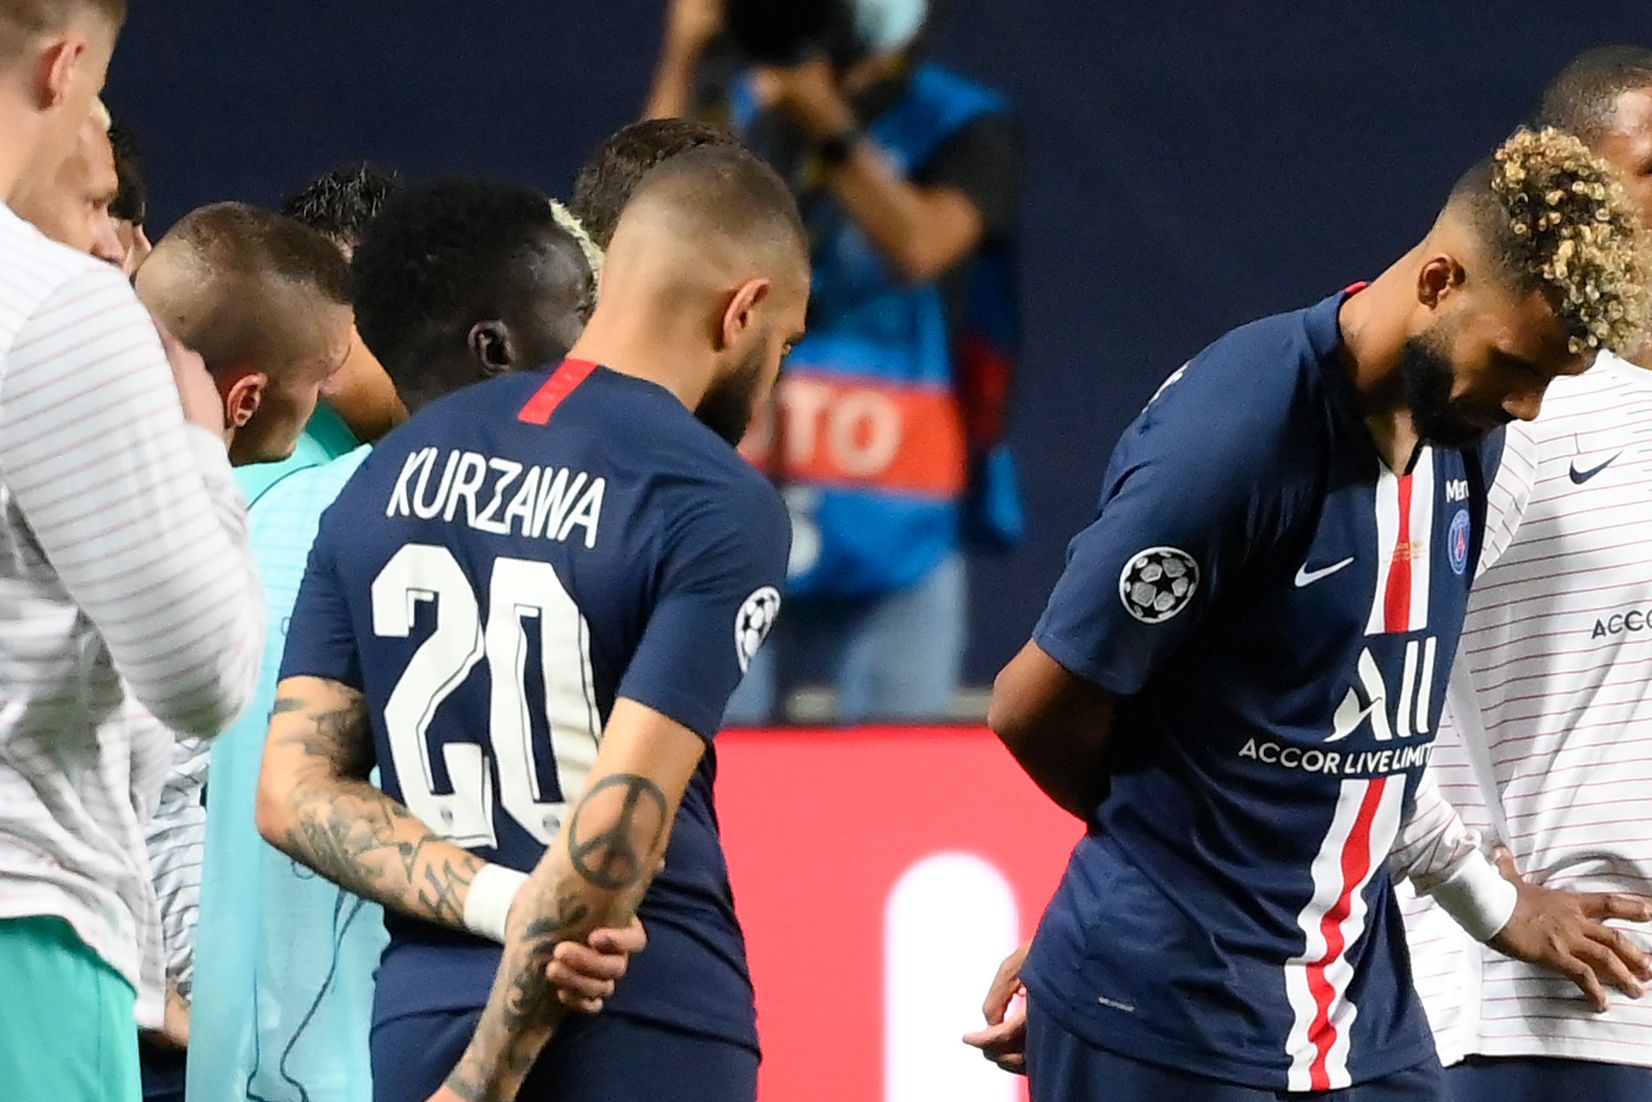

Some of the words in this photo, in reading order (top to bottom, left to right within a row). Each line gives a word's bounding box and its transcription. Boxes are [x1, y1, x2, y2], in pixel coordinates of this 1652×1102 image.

[741, 377, 902, 477] TO
[386, 446, 605, 549] KURZAWA
[371, 542, 603, 850] 20
[1238, 737, 1341, 774] ACCOR
[1344, 750, 1393, 774] LIVE
